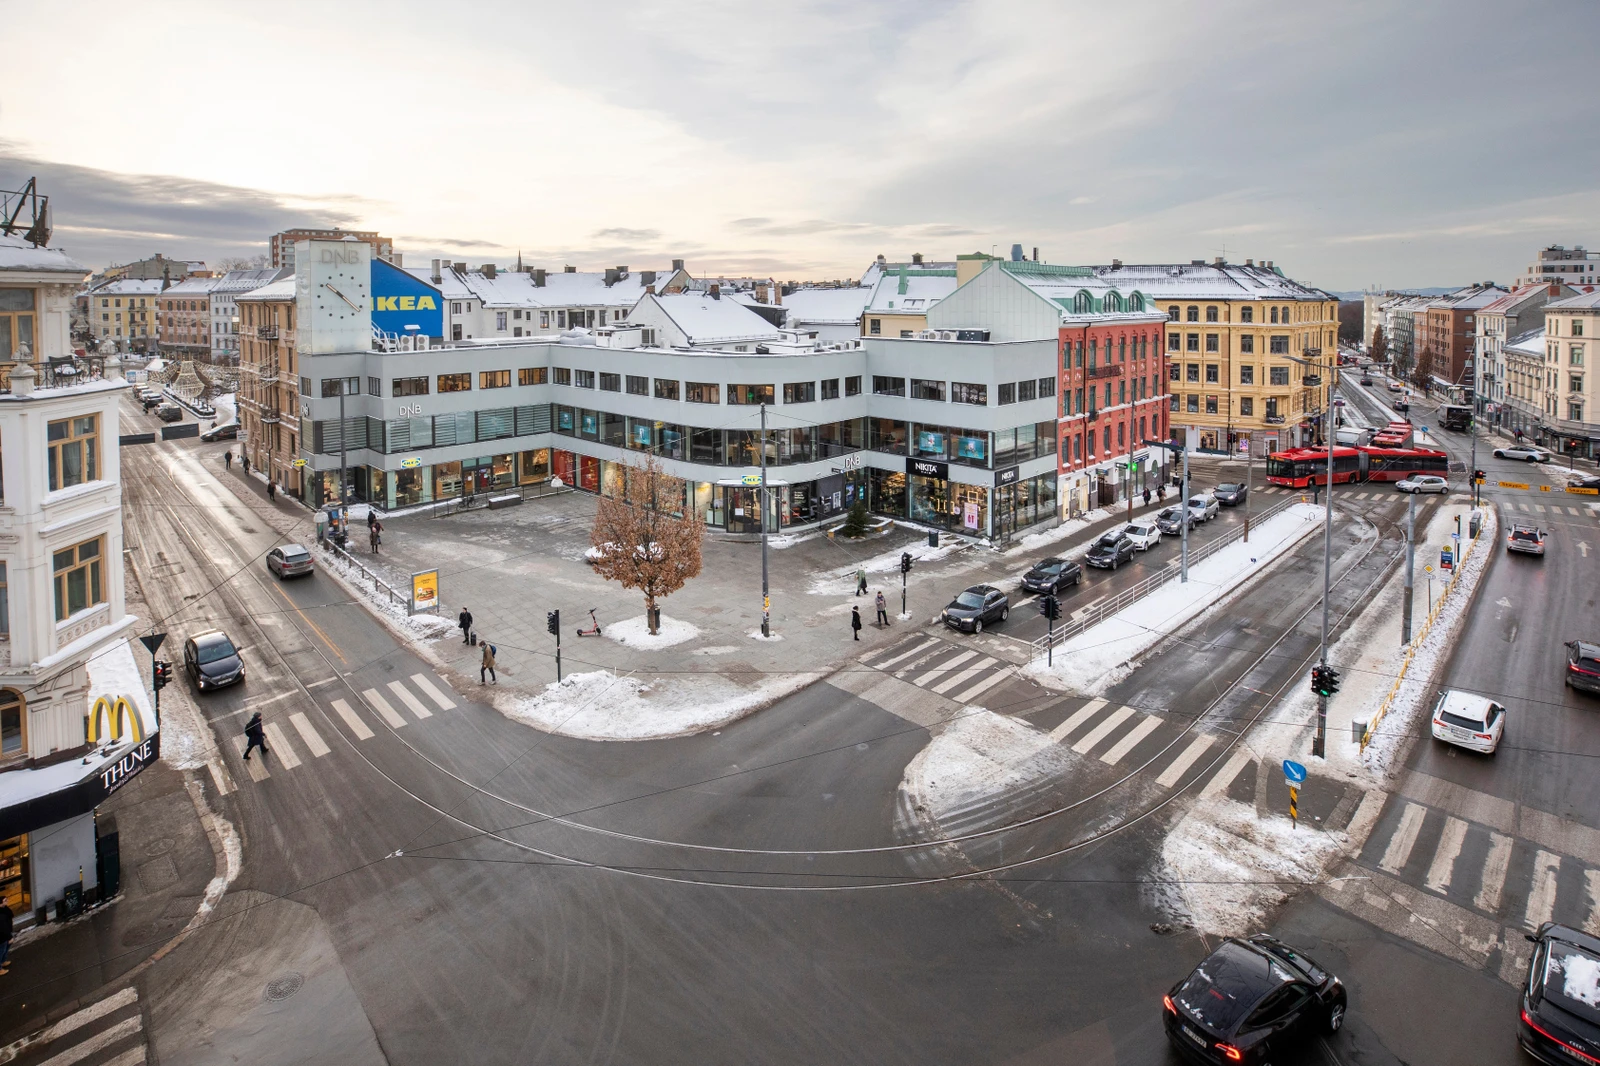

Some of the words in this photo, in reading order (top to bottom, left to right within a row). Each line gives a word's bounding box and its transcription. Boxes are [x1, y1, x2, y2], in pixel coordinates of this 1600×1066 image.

[321, 249, 360, 269] DNB
[399, 403, 422, 418] DNB
[846, 455, 861, 469] DNB
[915, 462, 938, 473] NIKITA
[1001, 471, 1015, 480] NIKITA
[101, 740, 152, 789] THUNE
